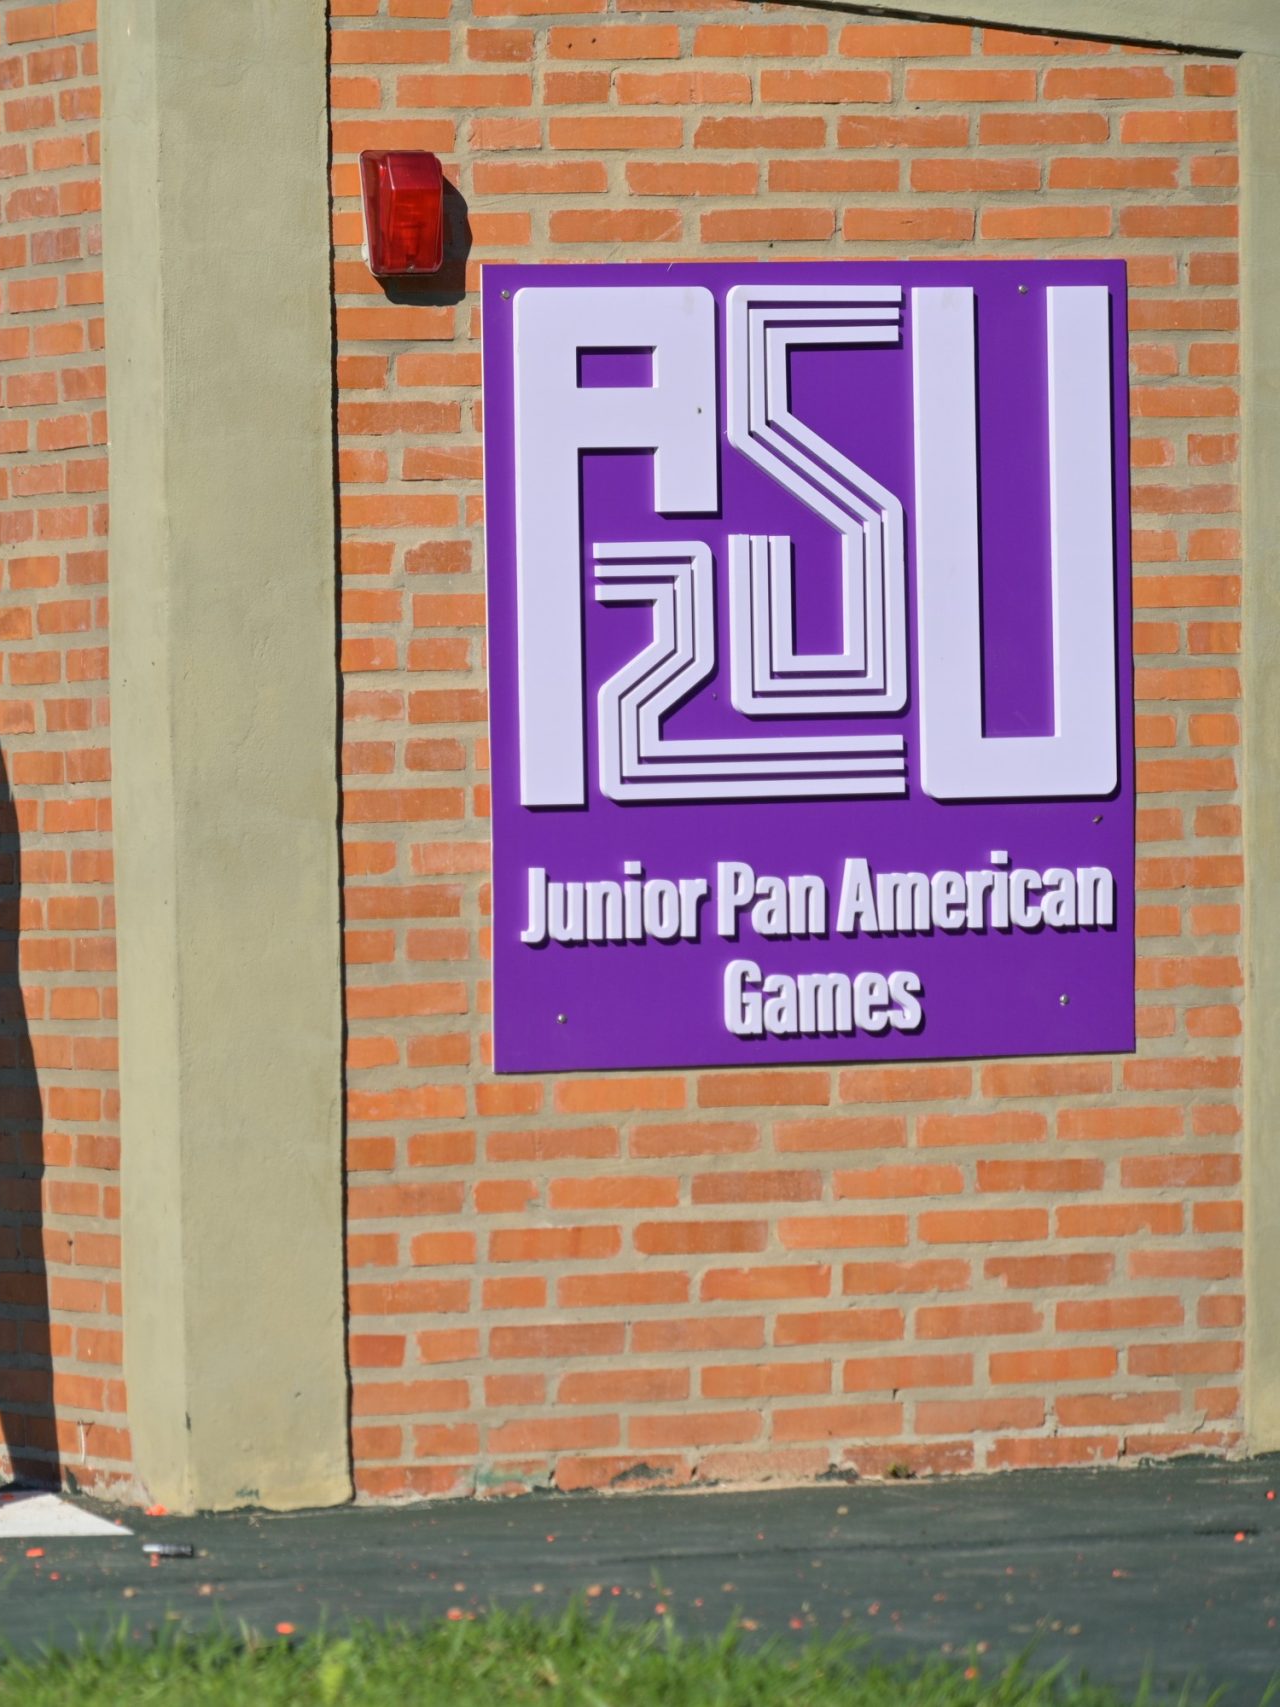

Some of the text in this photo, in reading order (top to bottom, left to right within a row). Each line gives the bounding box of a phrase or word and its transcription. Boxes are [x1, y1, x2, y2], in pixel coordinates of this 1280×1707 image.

[520, 850, 1113, 943] Junior Pan American
[723, 959, 922, 1035] Games
